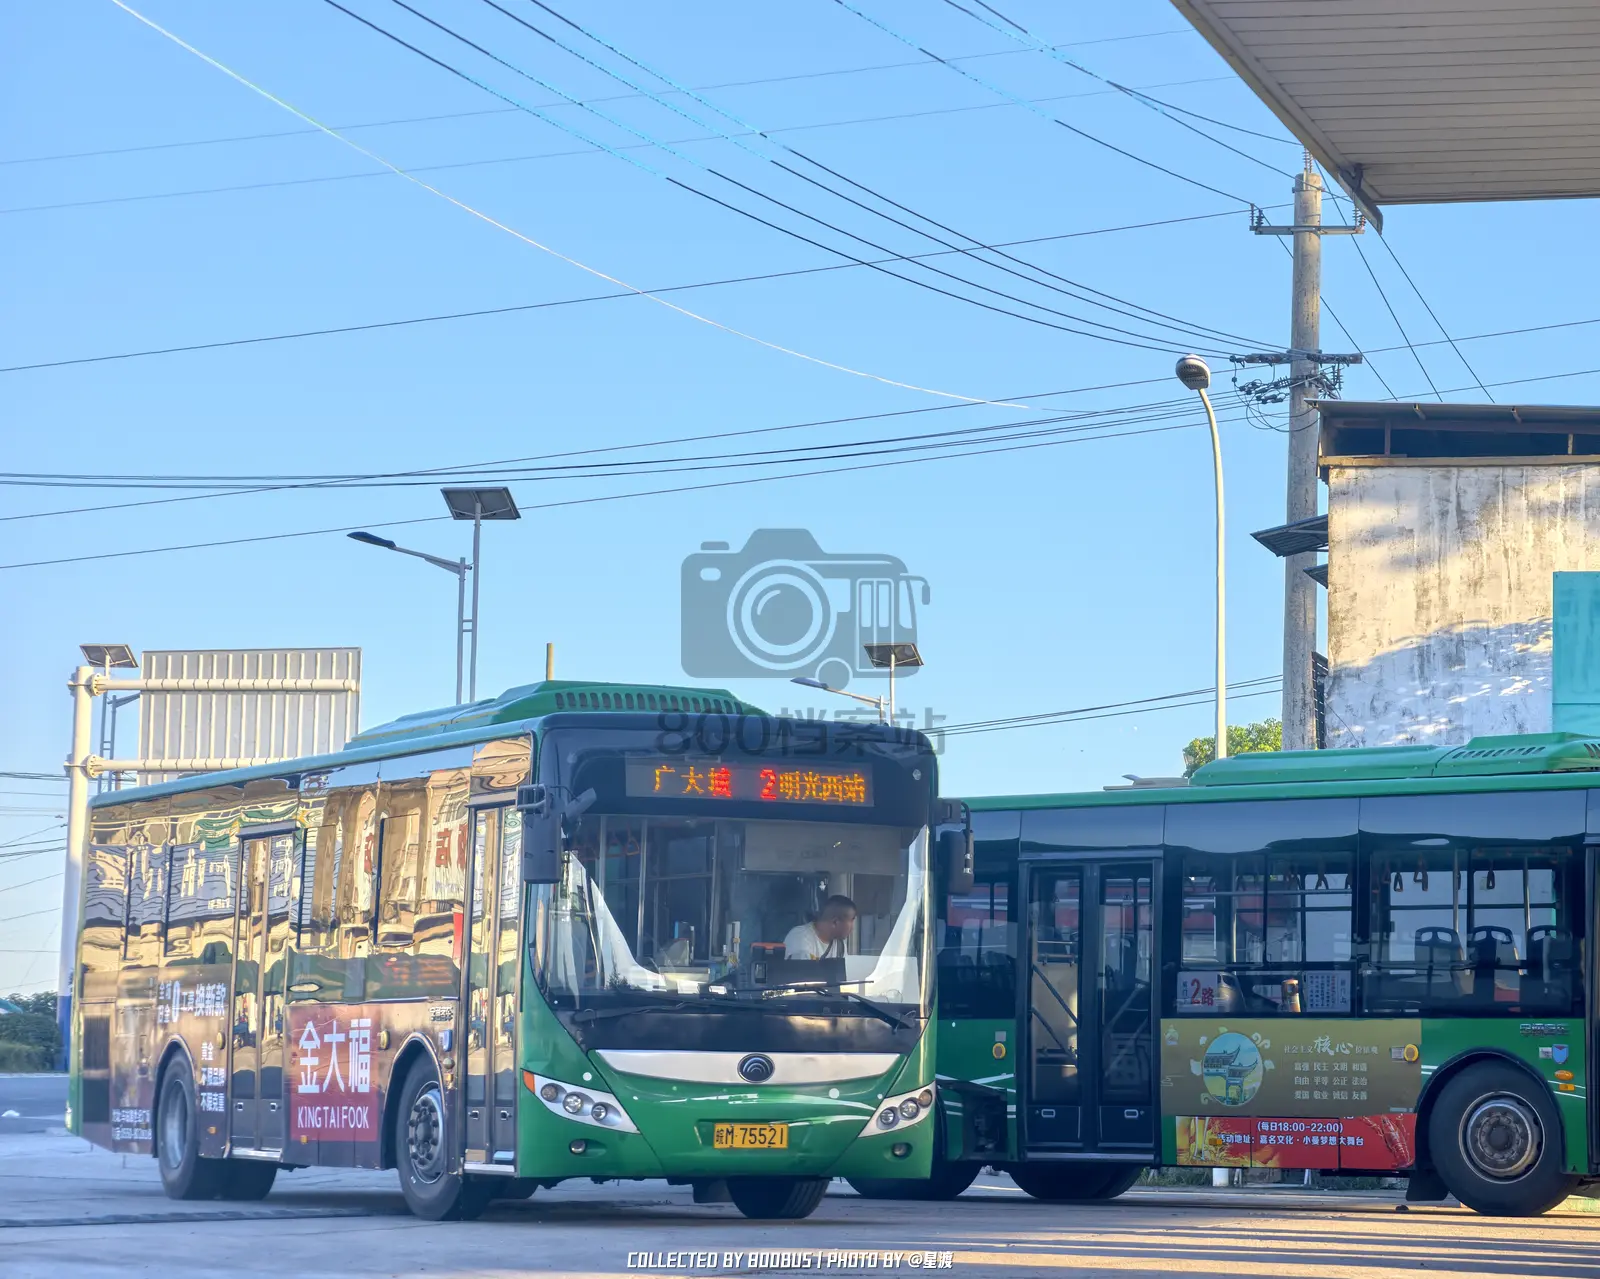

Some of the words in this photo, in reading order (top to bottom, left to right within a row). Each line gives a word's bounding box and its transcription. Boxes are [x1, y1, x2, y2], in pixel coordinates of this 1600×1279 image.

[297, 1018, 372, 1094] 金大福
[297, 1105, 322, 1129] KING
[323, 1105, 340, 1129] TAI
[341, 1105, 370, 1129] FOOK
[1257, 1121, 1344, 1133] (每日18:00-22:00)
